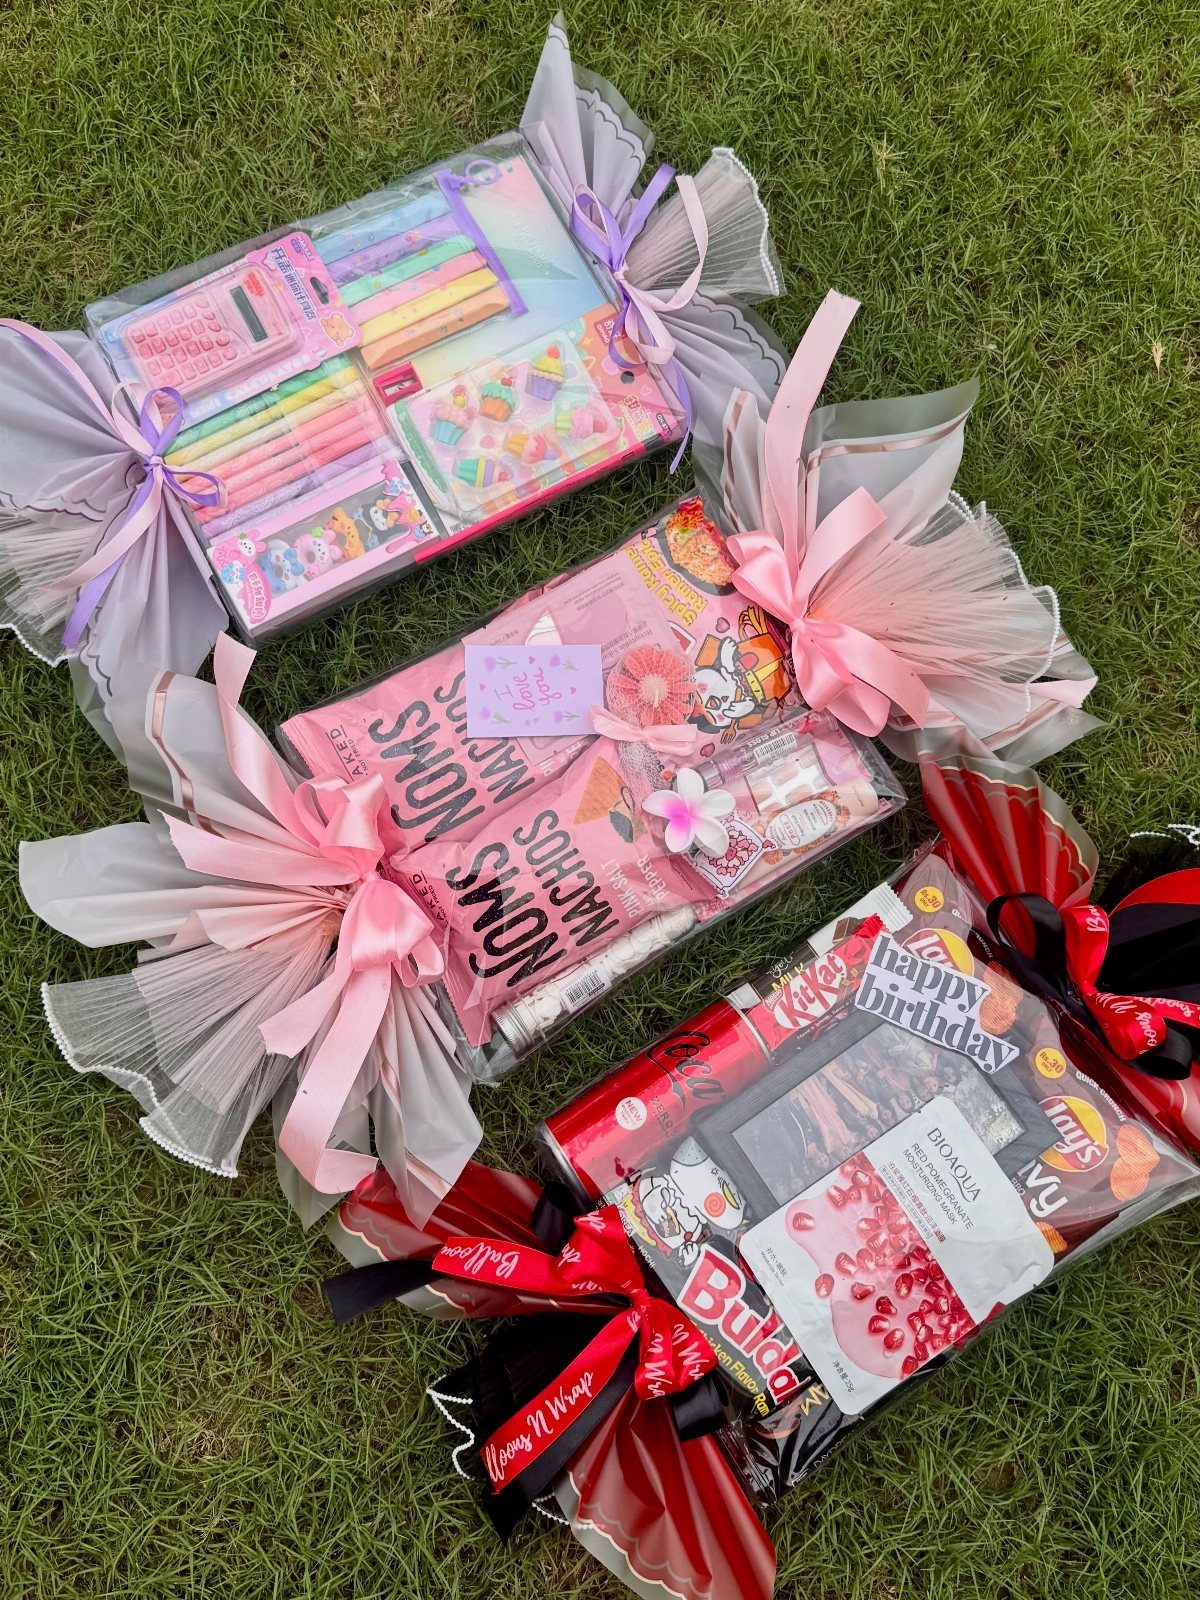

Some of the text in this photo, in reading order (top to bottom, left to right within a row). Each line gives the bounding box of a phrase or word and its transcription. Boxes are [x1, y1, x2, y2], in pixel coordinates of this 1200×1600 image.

[625, 545, 697, 627] Spicy Rame
[662, 568, 709, 614] Ramen
[494, 684, 513, 700] I
[513, 672, 536, 711] love
[532, 667, 562, 707] you
[330, 726, 362, 776] AKED
[434, 671, 535, 804] NACS
[368, 700, 486, 843] NOMS
[414, 874, 445, 921] AKED
[513, 809, 620, 947] NACHOS
[600, 858, 643, 919] PINK SALT
[445, 841, 568, 988] NOMS
[870, 934, 989, 1013] happy
[857, 972, 1015, 1072] birthday
[626, 1100, 642, 1122] NEW
[651, 1096, 673, 1128] ZERO
[902, 1149, 943, 1203] MOISTURIZING
[939, 1202, 958, 1225] MASK
[911, 1142, 974, 1230] RED POMEGRANATE
[927, 1127, 981, 1202] BIOAQUA
[1017, 1160, 1069, 1218] vy
[619, 1210, 635, 1237] OREA
[638, 1245, 656, 1269] HOCHI
[680, 1245, 804, 1406] Bulda
[643, 1360, 673, 1398] Wra
[690, 1320, 732, 1367] icken
[729, 1360, 759, 1395] Flavor
[544, 1371, 594, 1421] Wrap
